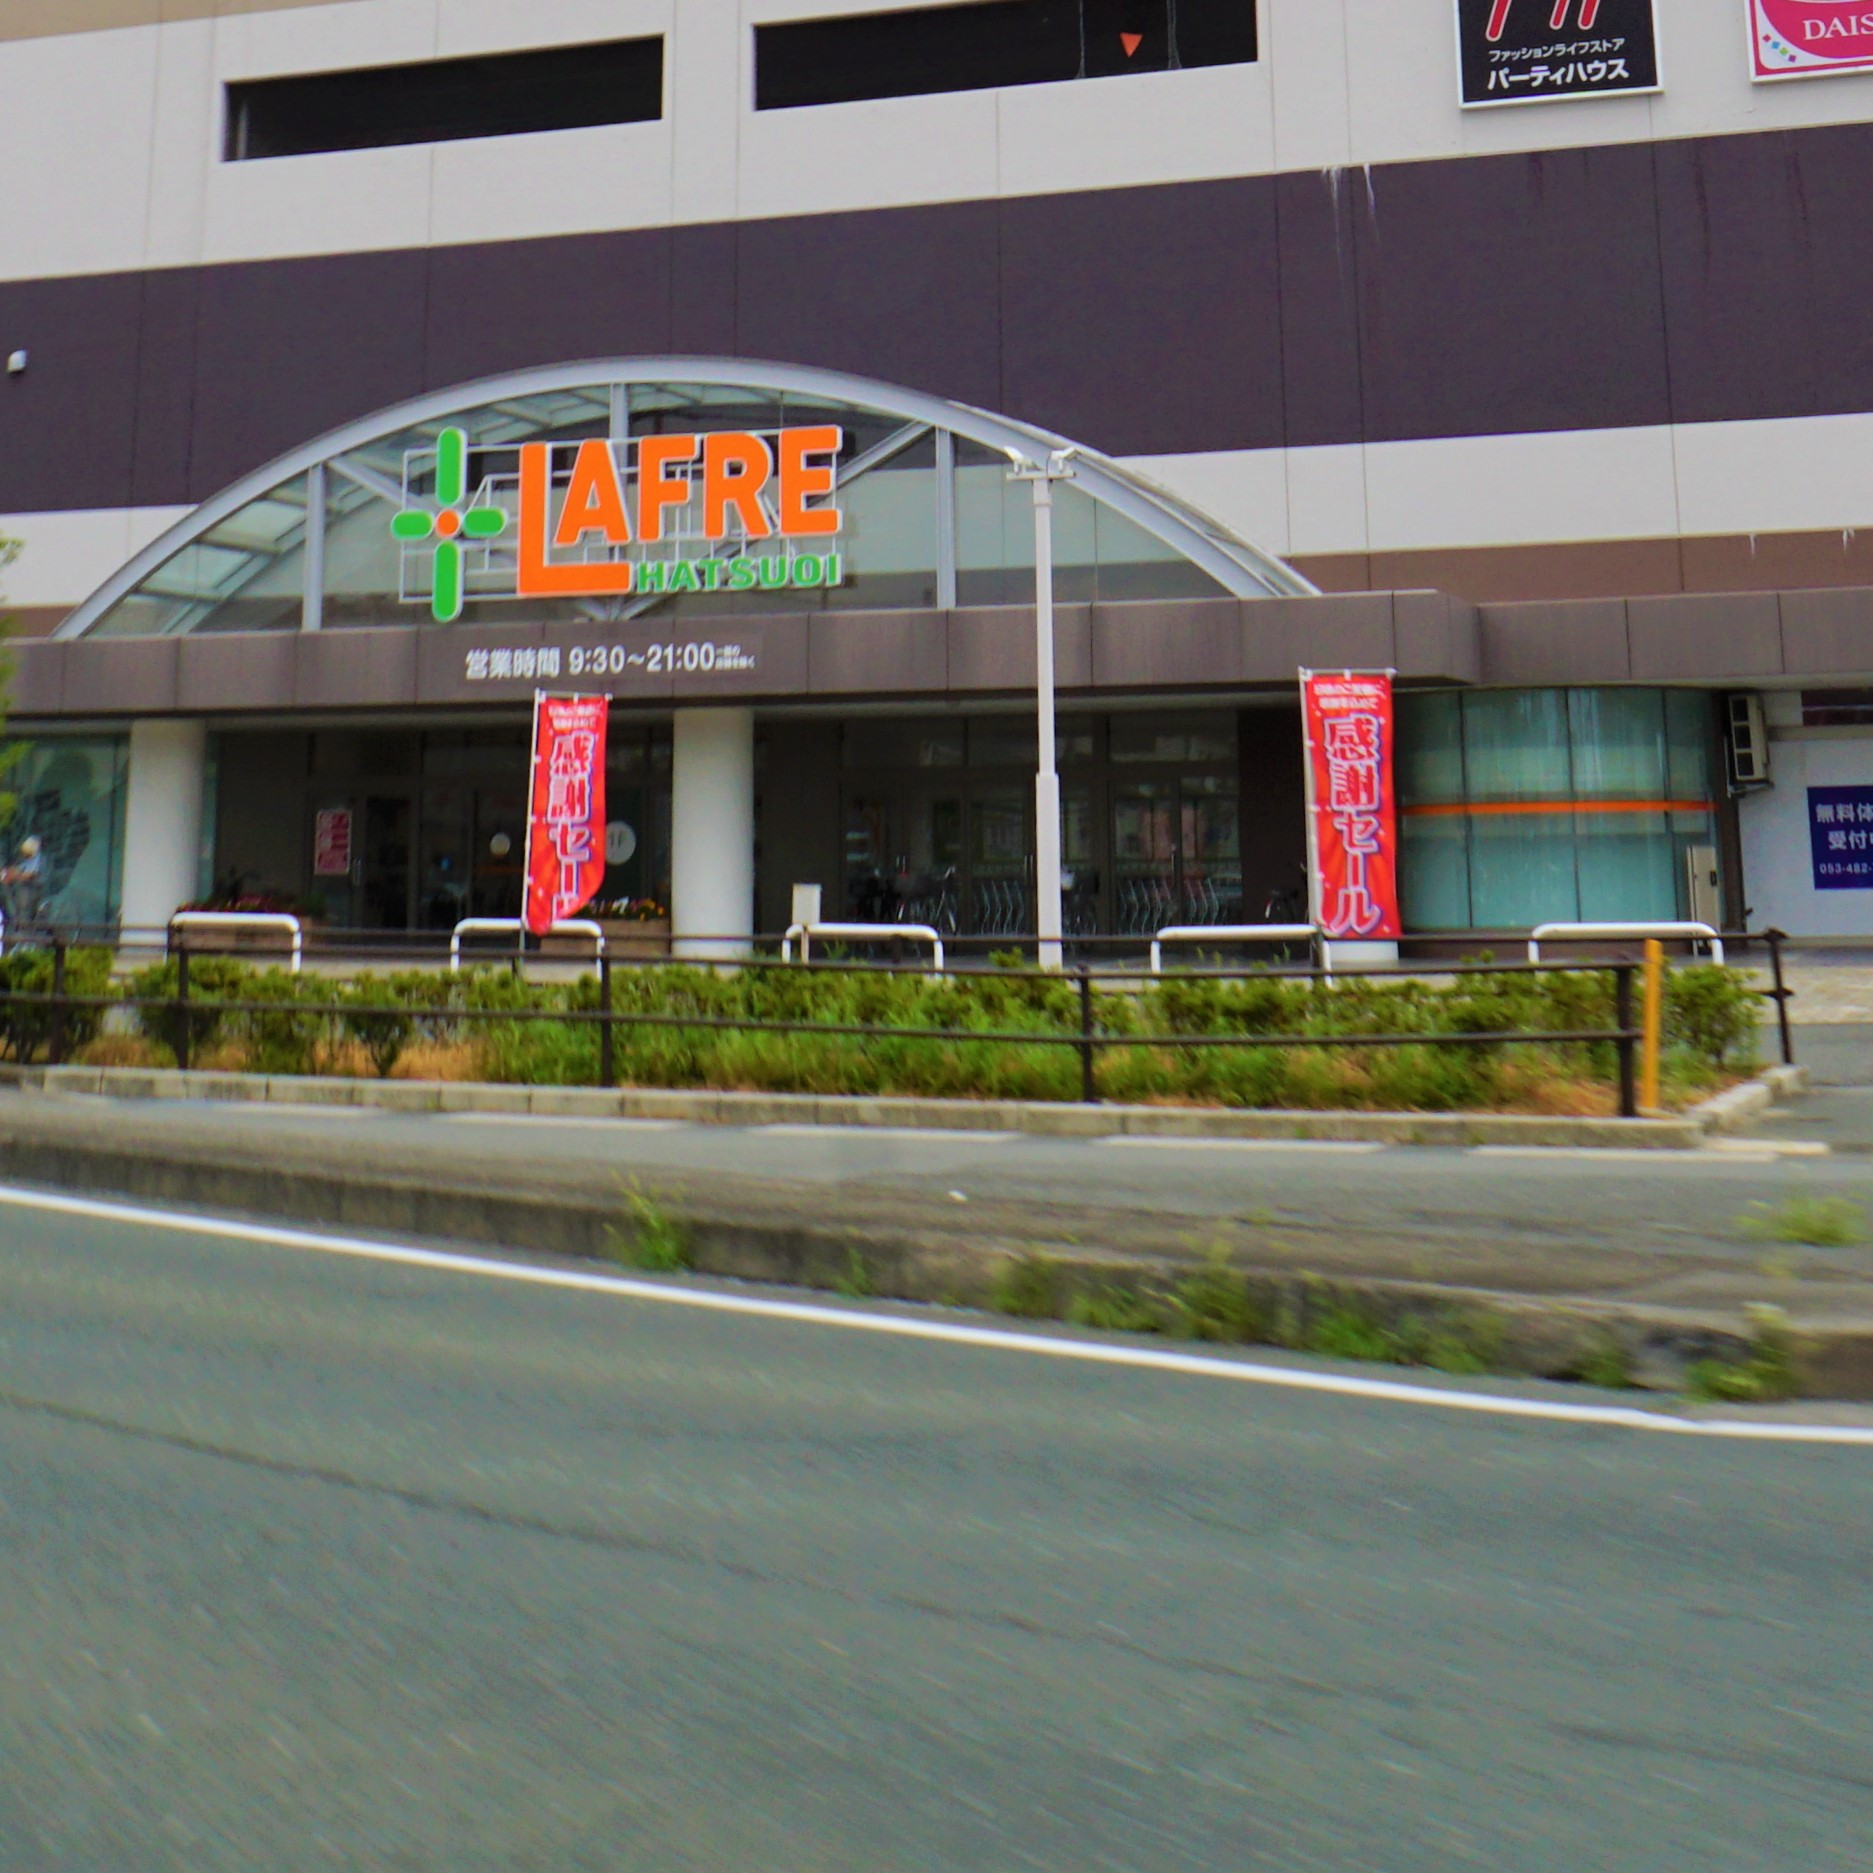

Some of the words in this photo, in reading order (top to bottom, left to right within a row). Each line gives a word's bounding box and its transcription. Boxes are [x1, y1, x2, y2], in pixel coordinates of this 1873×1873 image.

[1488, 38, 1626, 63] ファッションライフストア
[1487, 58, 1630, 90] パーティハウス
[517, 424, 843, 597] LAFRE
[636, 552, 842, 594] HATSUOI
[465, 646, 561, 679] 営業時間
[1323, 712, 1382, 935] 感謝セール
